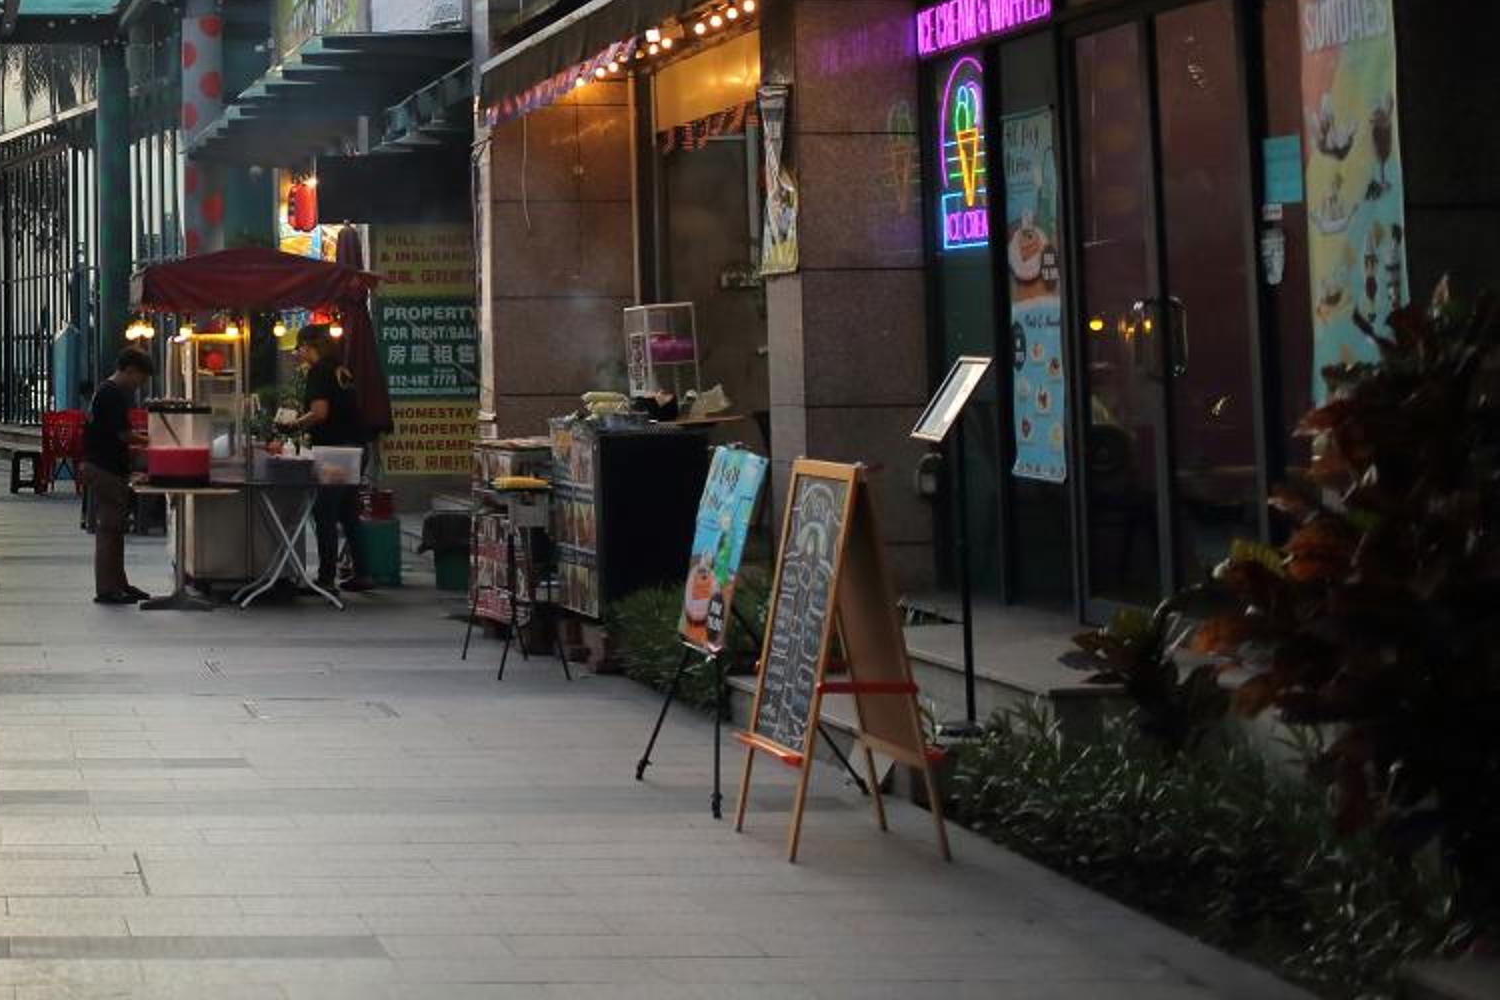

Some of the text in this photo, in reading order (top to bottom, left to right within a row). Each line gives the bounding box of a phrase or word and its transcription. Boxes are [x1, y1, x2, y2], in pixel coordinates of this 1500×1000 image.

[917, 7, 936, 56] ICE
[383, 306, 476, 322] PROPERTY
[383, 326, 409, 341] FOR
[399, 423, 477, 435] PROPERTY
